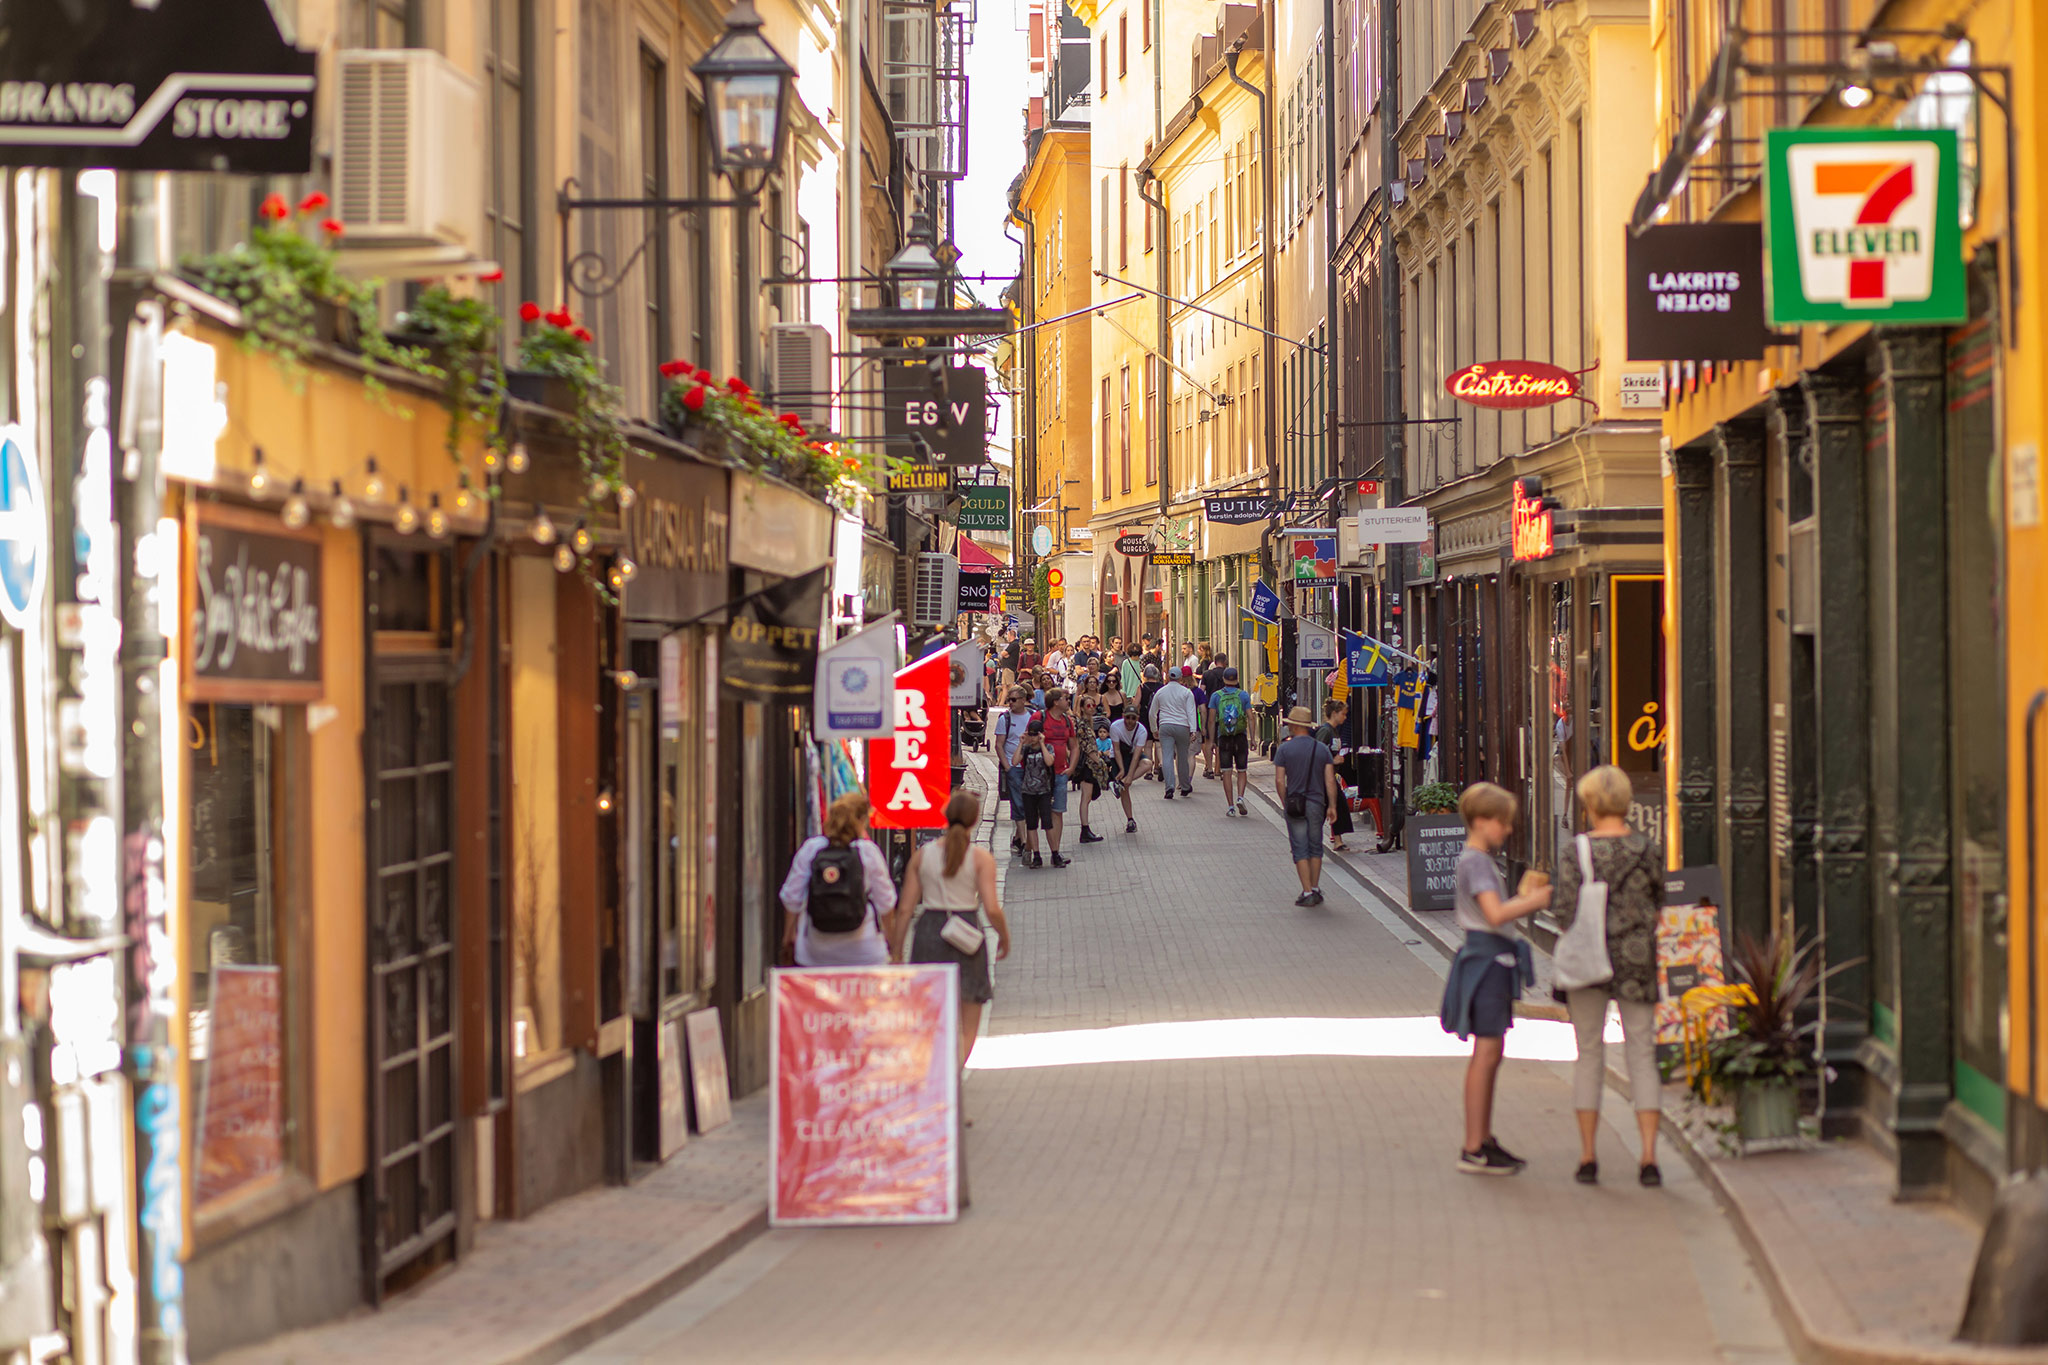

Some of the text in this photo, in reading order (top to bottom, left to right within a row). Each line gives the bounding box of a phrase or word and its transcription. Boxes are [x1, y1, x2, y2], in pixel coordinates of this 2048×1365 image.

[0, 82, 135, 123] BRANDS
[172, 97, 291, 139] STORE
[1813, 161, 1915, 299] 7
[1649, 271, 1740, 291] LAKRITS
[1657, 293, 1731, 312] ROTEN
[1453, 364, 1574, 398] Åströms
[1624, 393, 1640, 404] 1-3
[890, 471, 948, 489] MELLBIN
[1210, 500, 1266, 512] BUTIK
[958, 514, 1006, 526] SILVER
[1364, 516, 1422, 526] STUTTERHEIM
[1122, 545, 1150, 553] BURGERS
[960, 585, 988, 598] SNÖ
[1256, 594, 1270, 603] SHOP
[1253, 605, 1266, 613] FREE
[730, 616, 816, 649] ÖPPET
[886, 689, 932, 811] REA
[1420, 828, 1465, 837] STUTTERHEIM
[1426, 876, 1440, 890] AND
